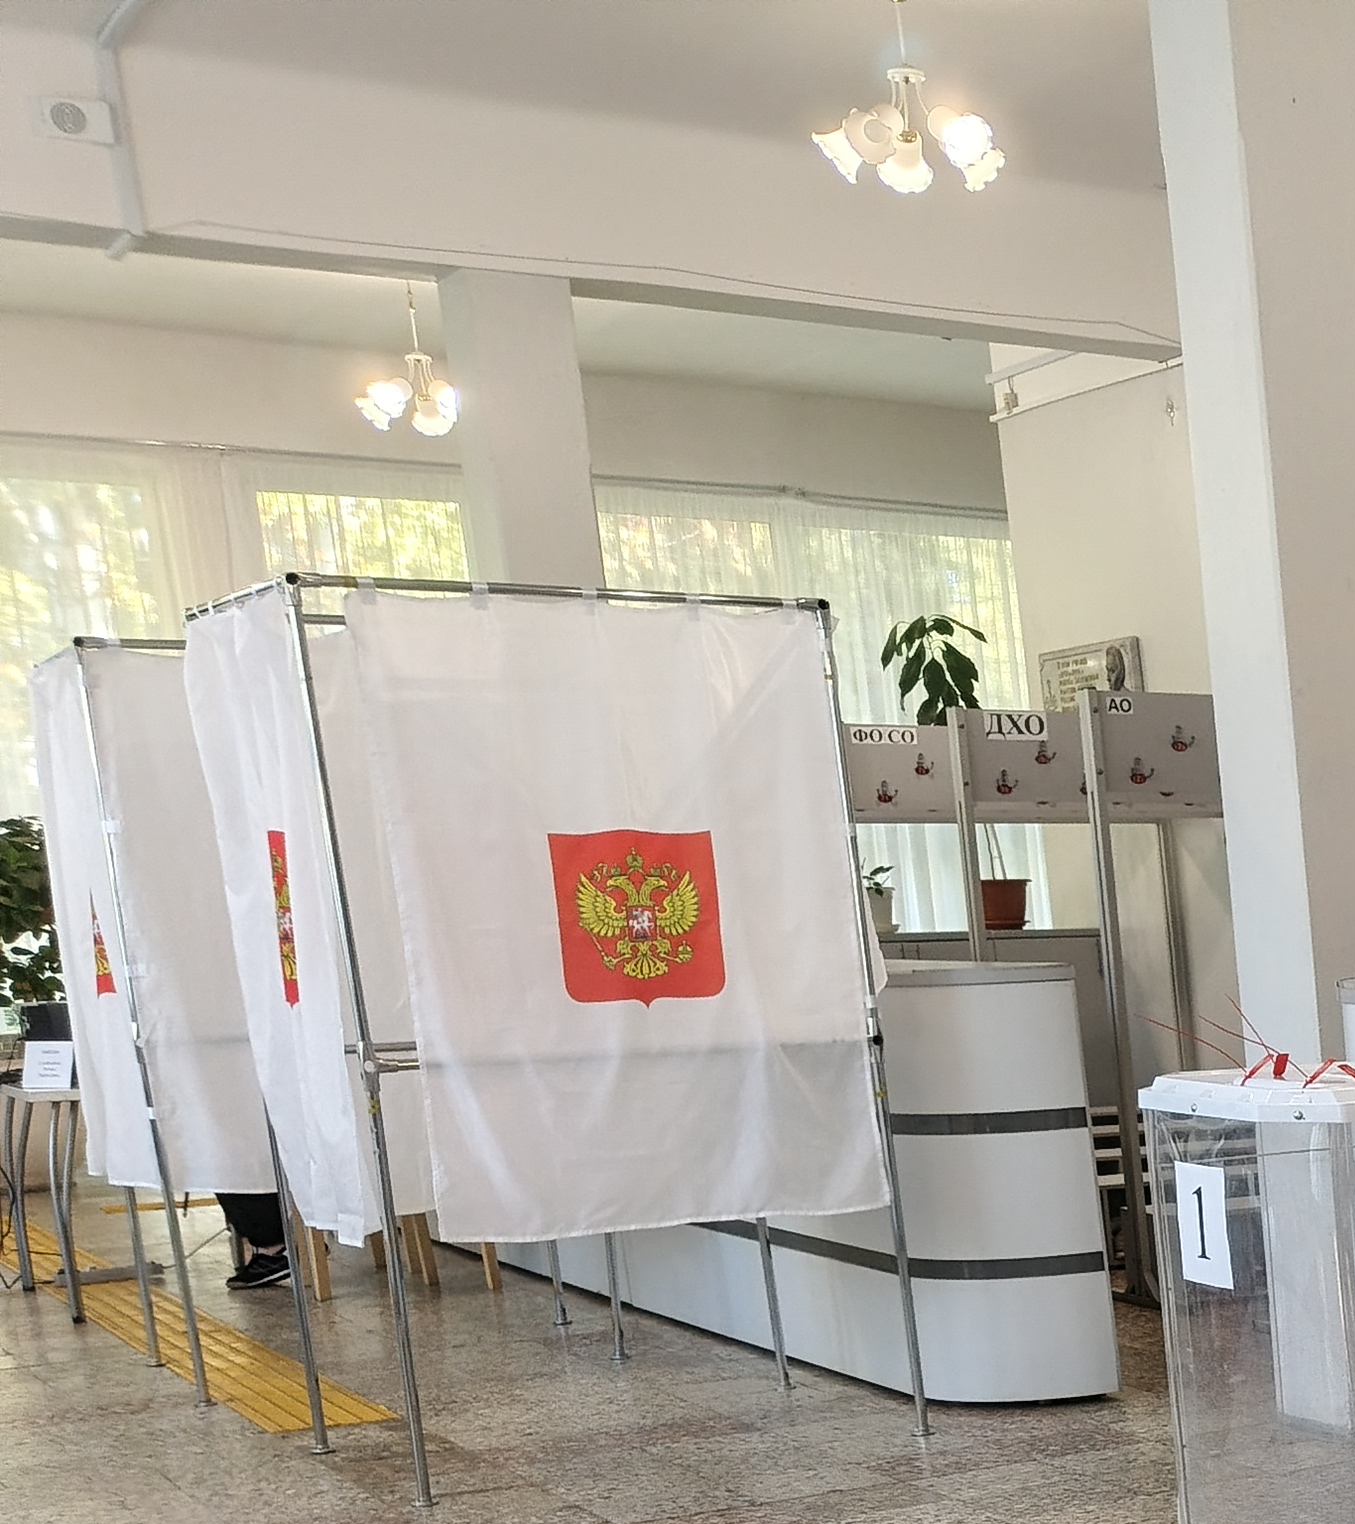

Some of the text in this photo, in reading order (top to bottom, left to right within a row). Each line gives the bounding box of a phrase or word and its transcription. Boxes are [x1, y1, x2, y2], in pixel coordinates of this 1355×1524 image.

[1108, 698, 1132, 713] АО
[986, 713, 1045, 738] ДХО
[852, 728, 915, 744] ФО СО
[1192, 1185, 1211, 1261] 1
